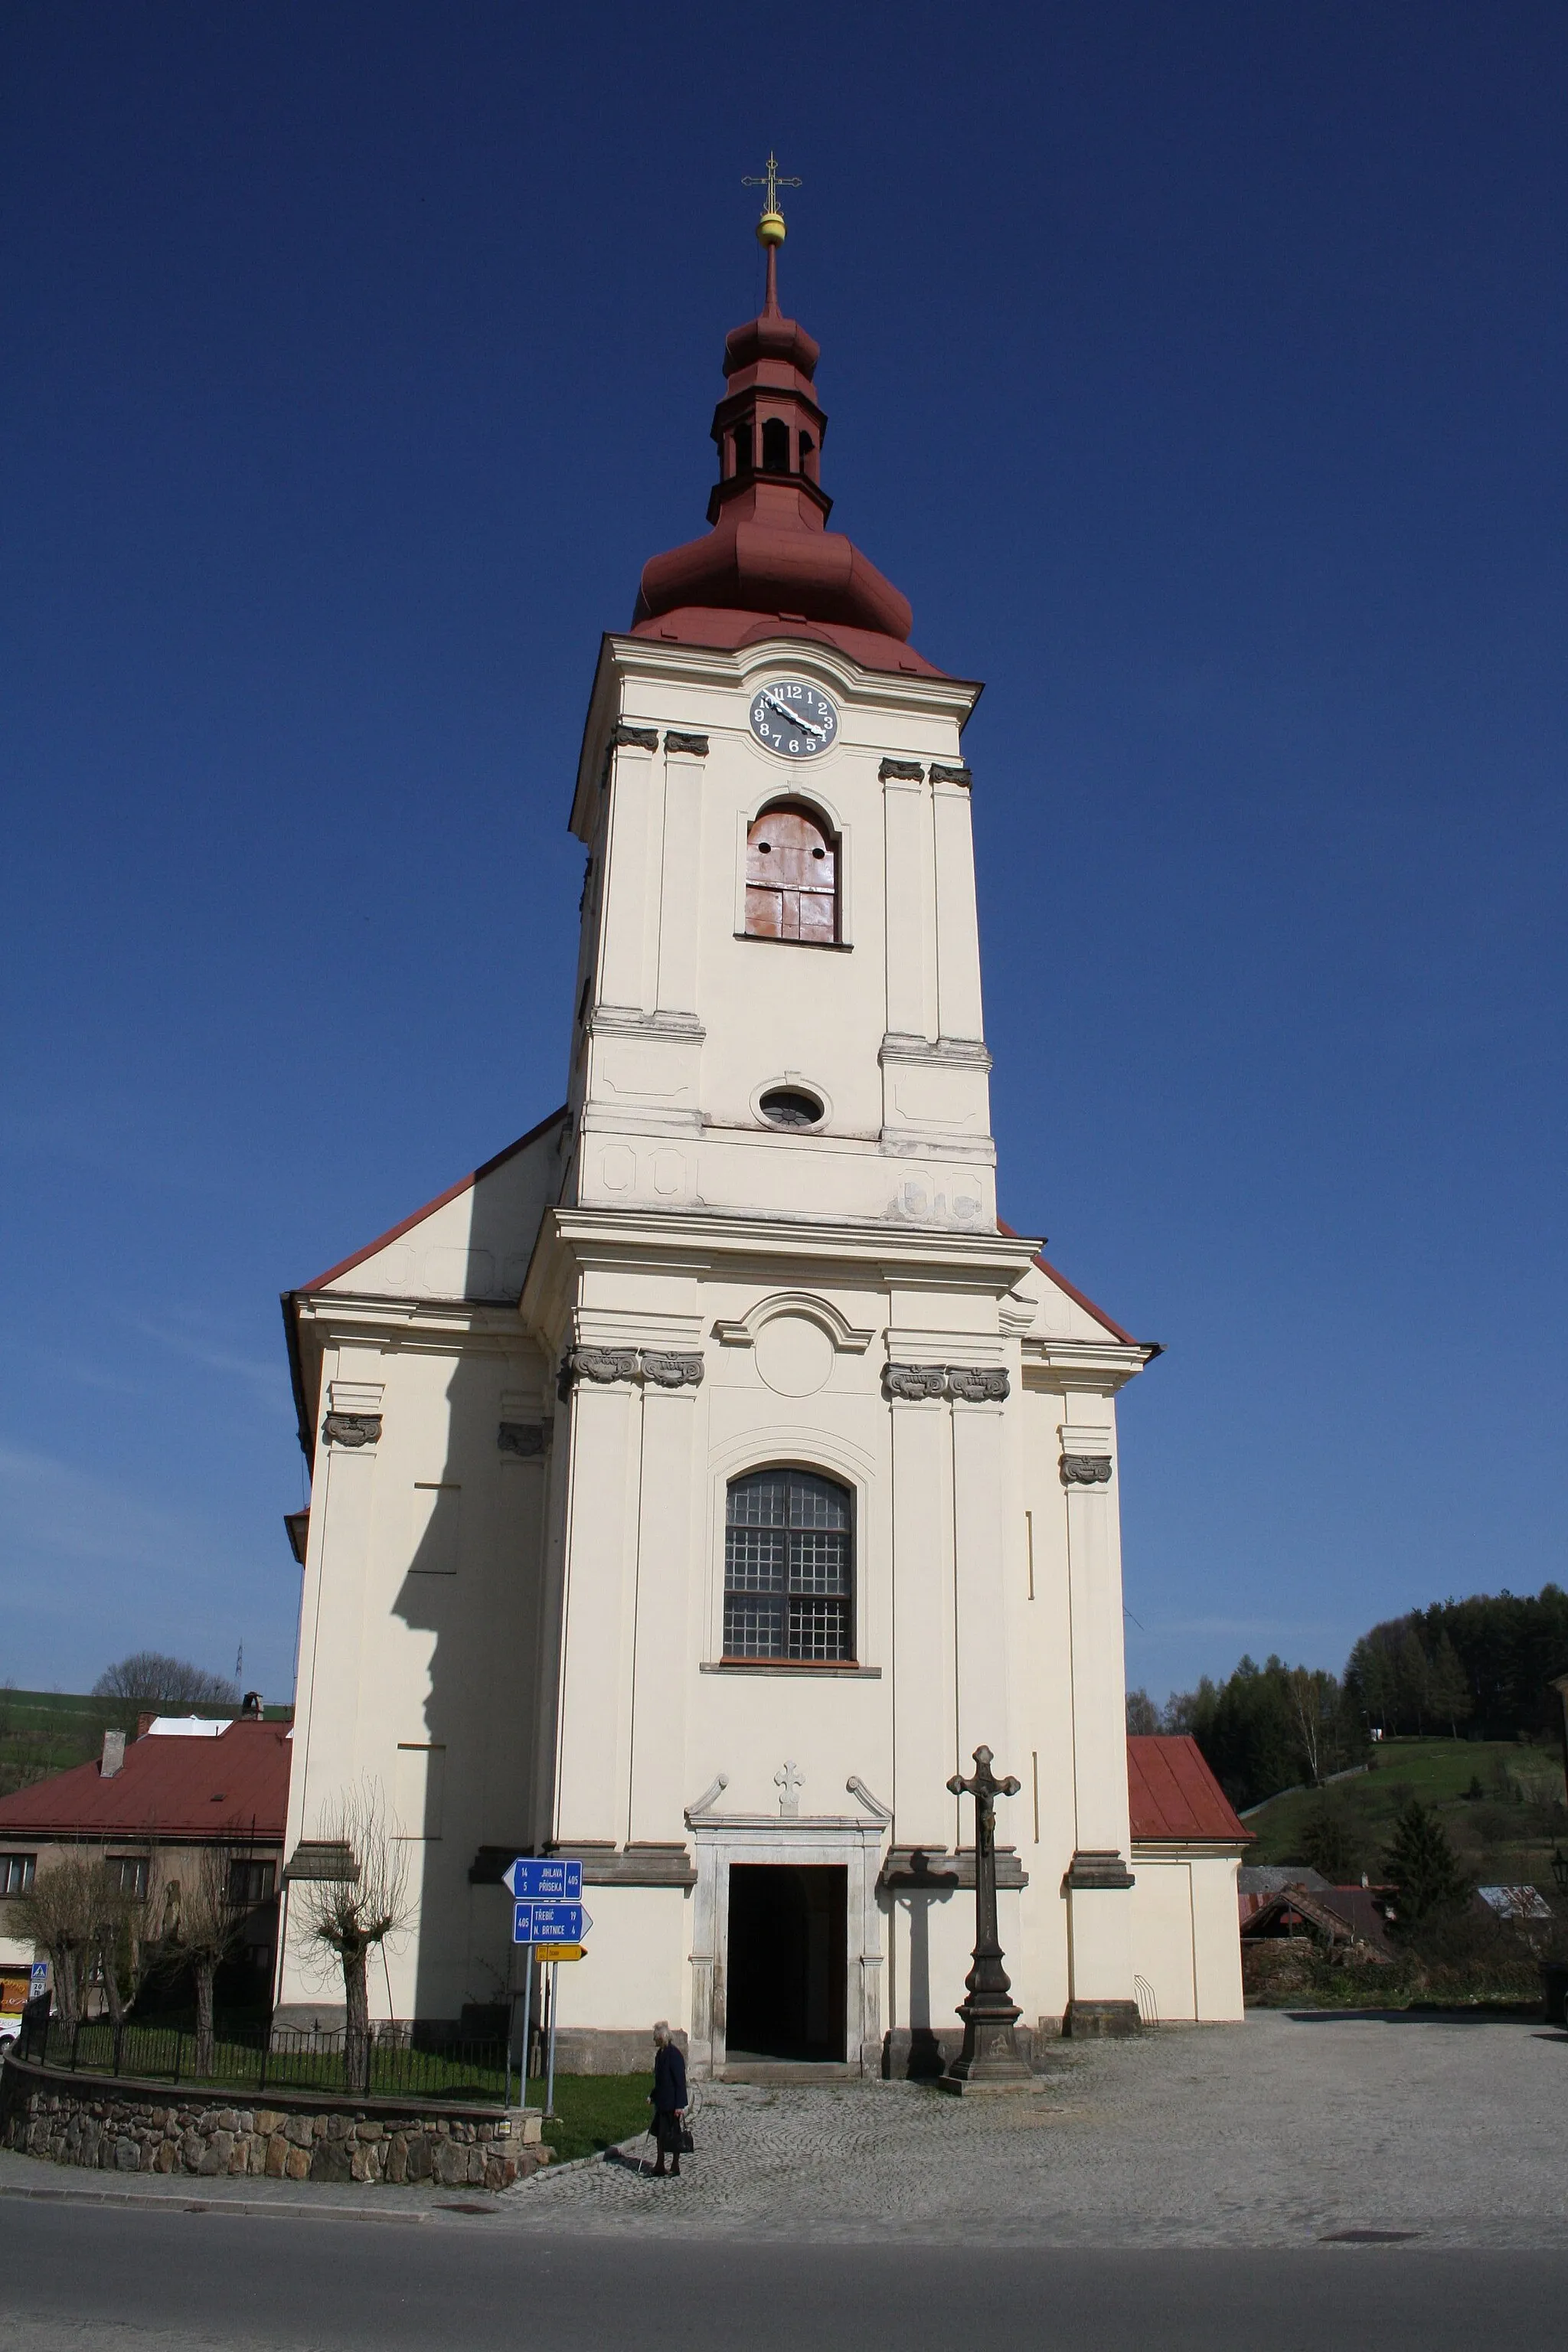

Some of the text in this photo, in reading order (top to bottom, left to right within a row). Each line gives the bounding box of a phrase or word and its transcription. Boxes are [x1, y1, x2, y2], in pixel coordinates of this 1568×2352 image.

[774, 688, 784, 701] 11
[786, 685, 802, 699] 12
[807, 691, 813, 704] 1
[818, 702, 828, 715] 2
[754, 709, 764, 722] 9
[824, 716, 833, 730] 3
[760, 724, 769, 736] 8
[773, 734, 782, 747] 7
[789, 740, 799, 753] 6
[806, 738, 816, 751] 5
[521, 1867, 563, 1878] 14 JIHLAVA
[523, 1880, 563, 1892] 5 PŘÍSEKA
[567, 1876, 579, 1885] 405
[535, 1909, 577, 1921] TŘEBÍČ 19
[518, 1917, 529, 1928] 405
[534, 1926, 540, 1936] N.
[542, 1925, 565, 1936] BRTNICE
